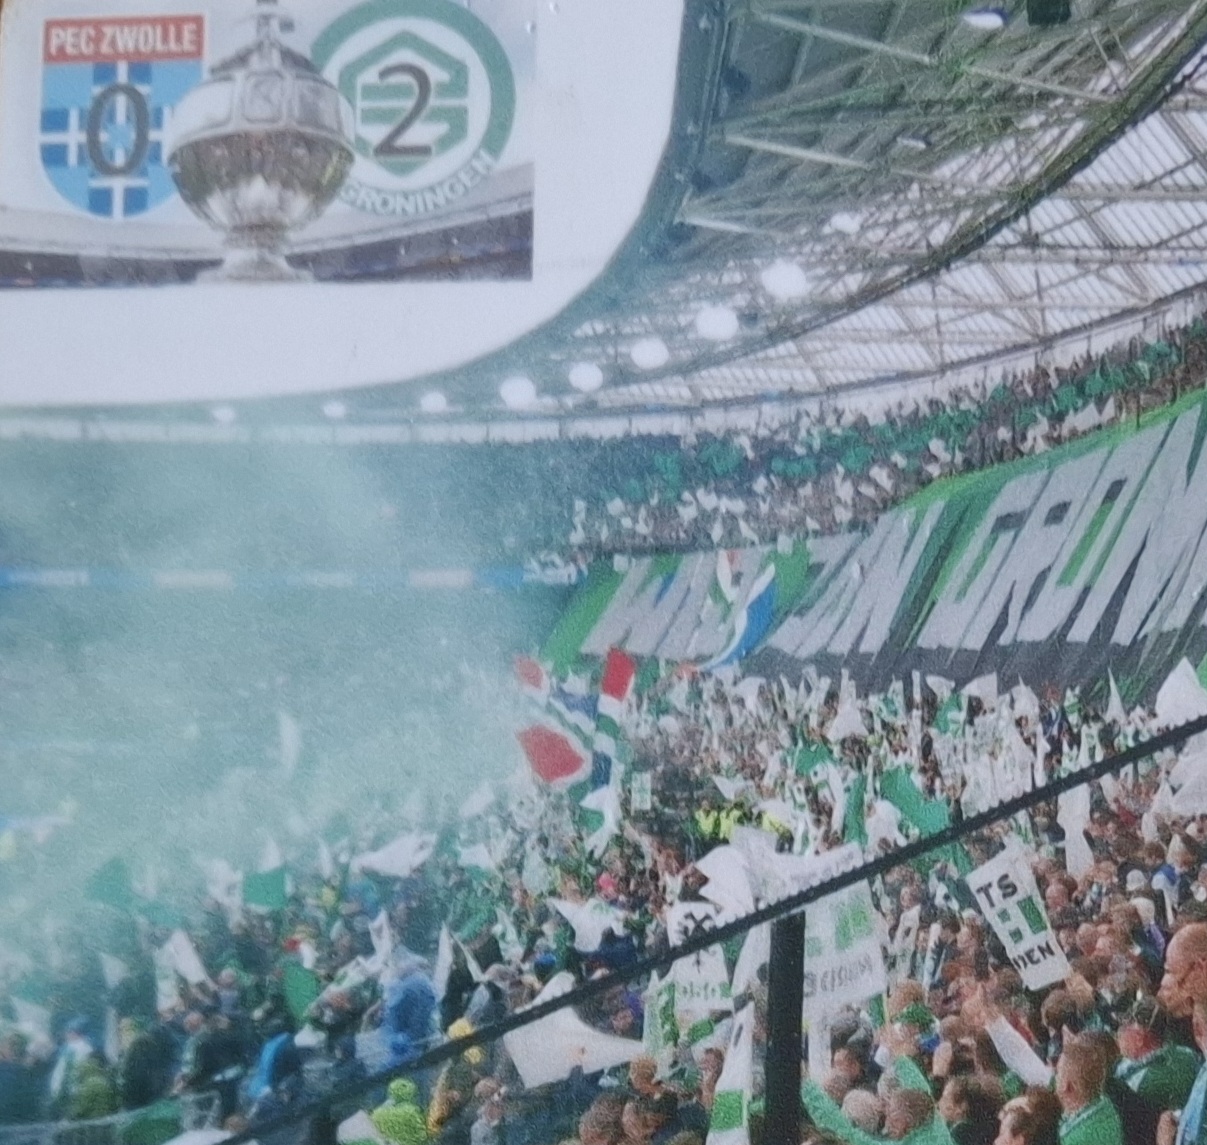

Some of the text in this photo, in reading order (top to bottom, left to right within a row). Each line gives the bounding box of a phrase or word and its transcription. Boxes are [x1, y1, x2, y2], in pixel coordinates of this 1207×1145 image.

[50, 23, 197, 56] PEC ZWOLLE
[86, 83, 150, 175] 0
[373, 63, 433, 156] 2
[340, 150, 496, 216] GRONINGEN
